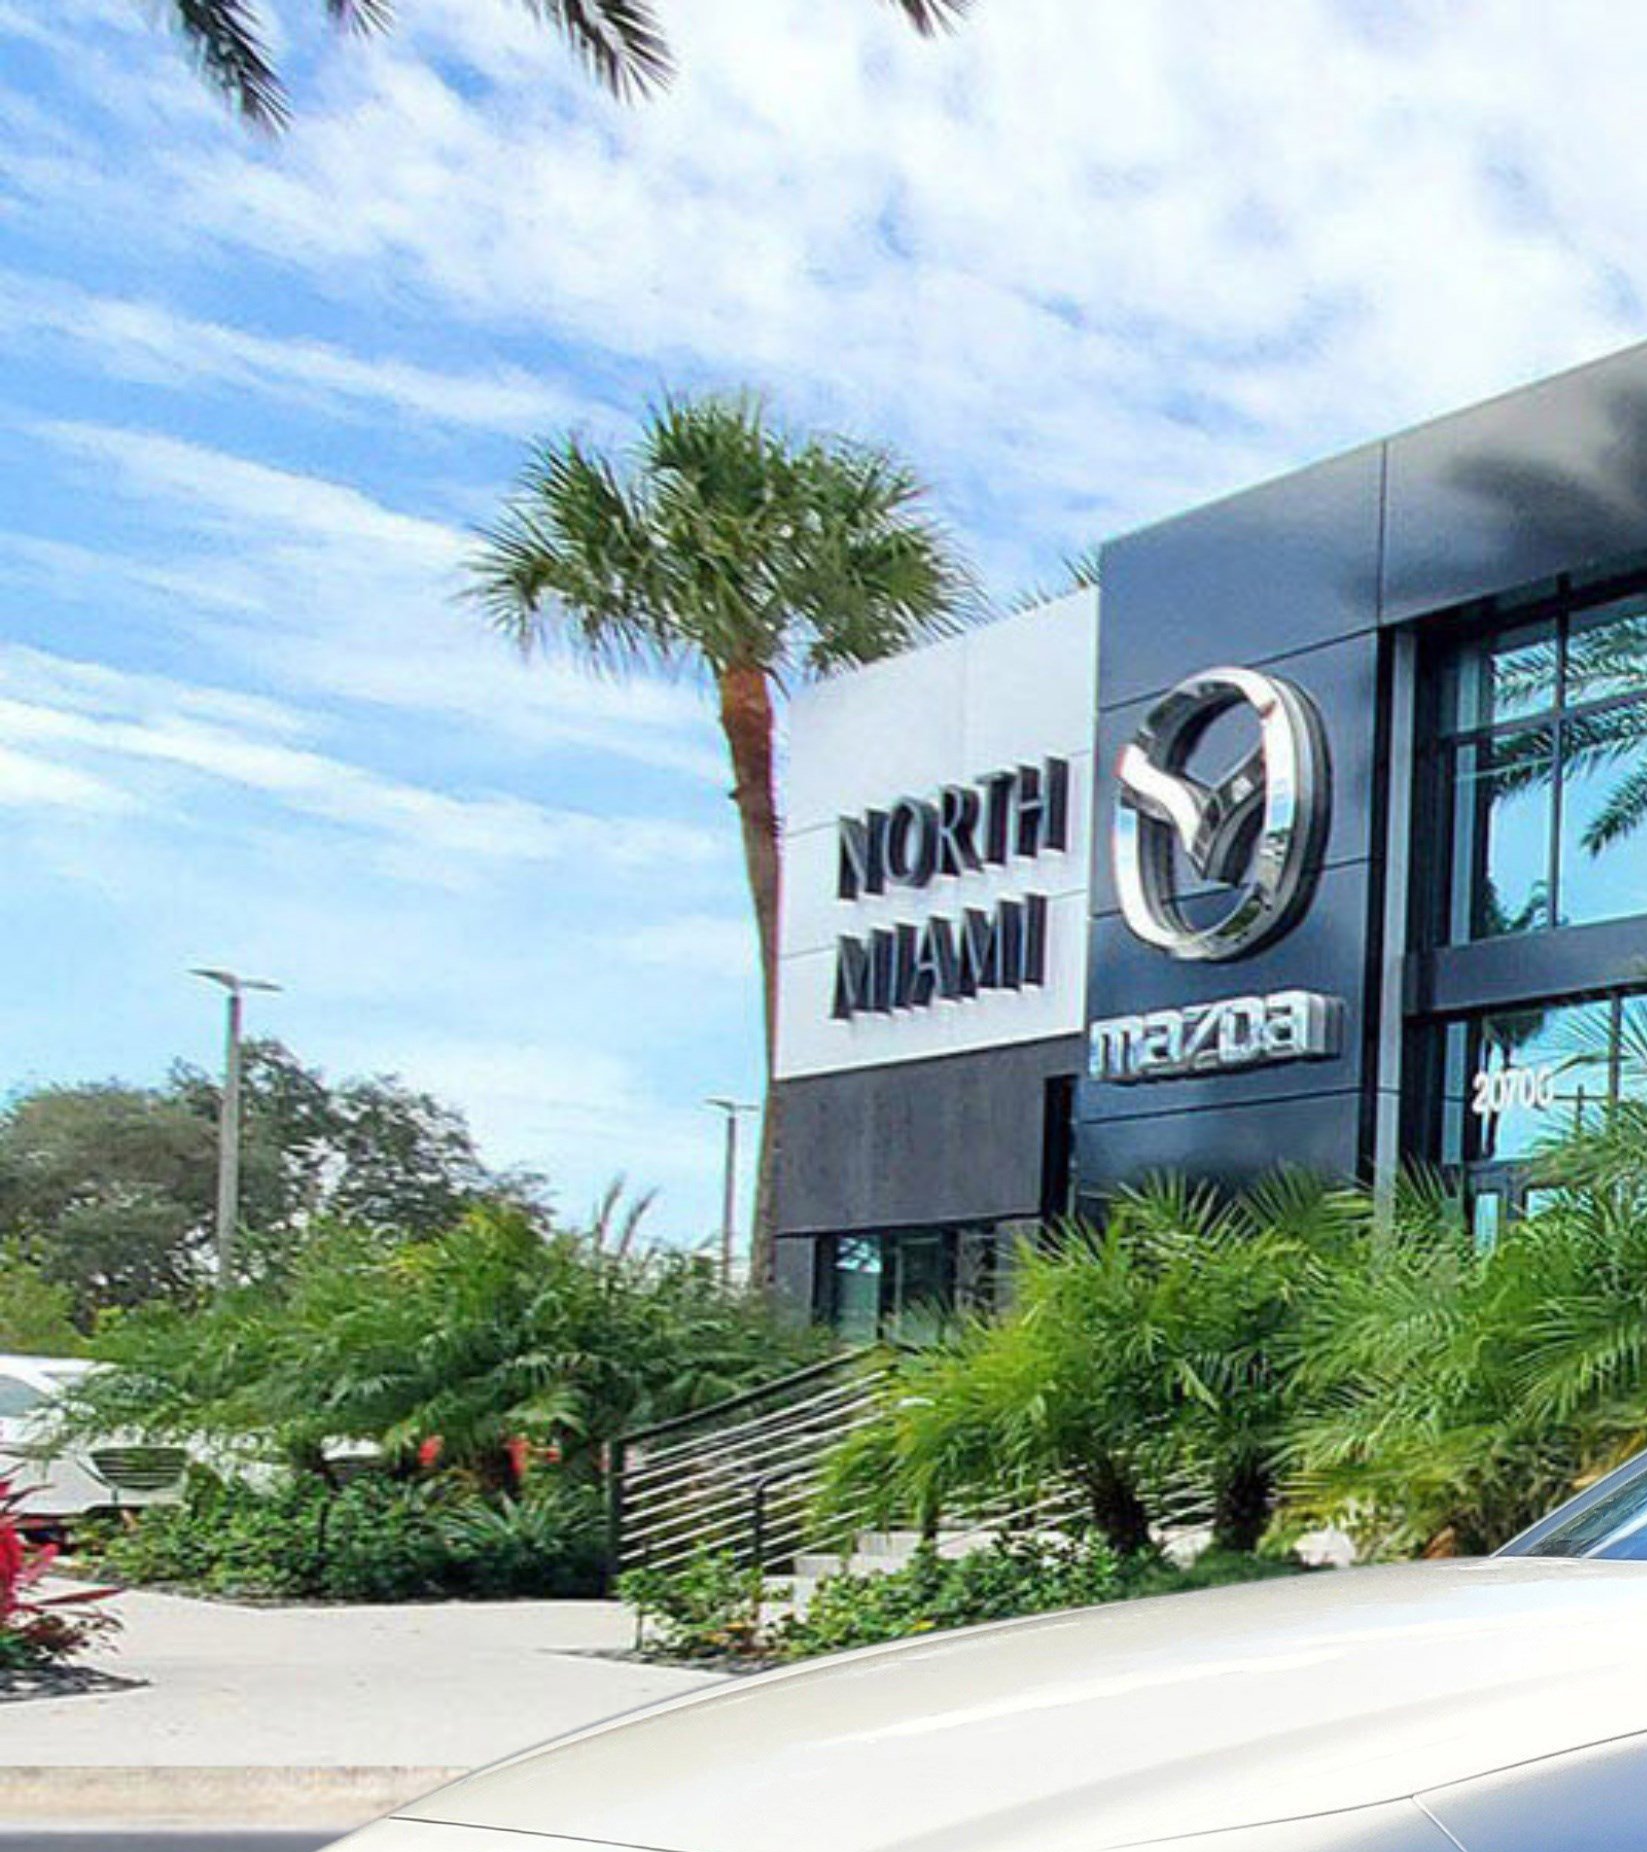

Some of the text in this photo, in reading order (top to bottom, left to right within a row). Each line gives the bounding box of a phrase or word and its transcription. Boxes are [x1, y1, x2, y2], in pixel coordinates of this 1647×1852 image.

[838, 755, 1069, 903] NORTH
[830, 892, 1048, 1020] MIAMI
[1088, 989, 1340, 1083] mazda
